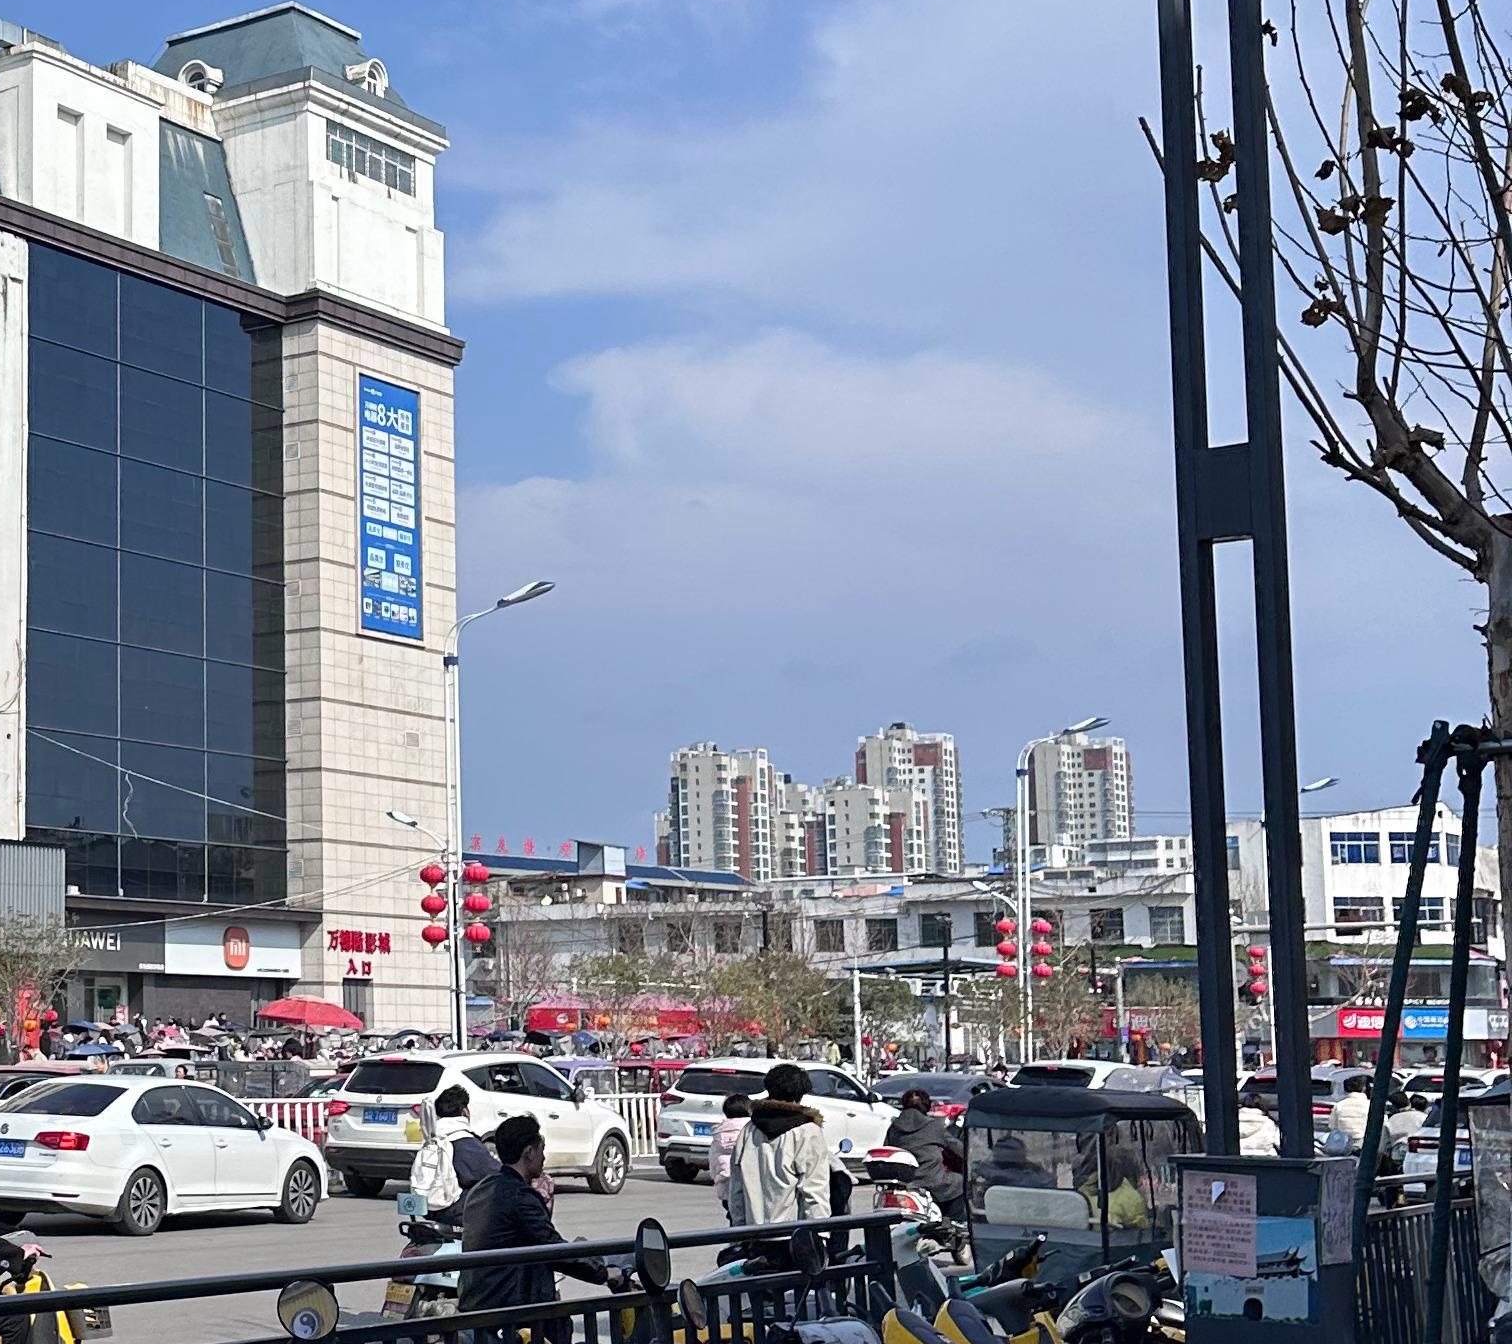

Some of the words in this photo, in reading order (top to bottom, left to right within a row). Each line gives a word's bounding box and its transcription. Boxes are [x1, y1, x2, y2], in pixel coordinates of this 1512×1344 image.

[326, 929, 392, 955] 万德隆影城
[346, 959, 372, 976] 入口
